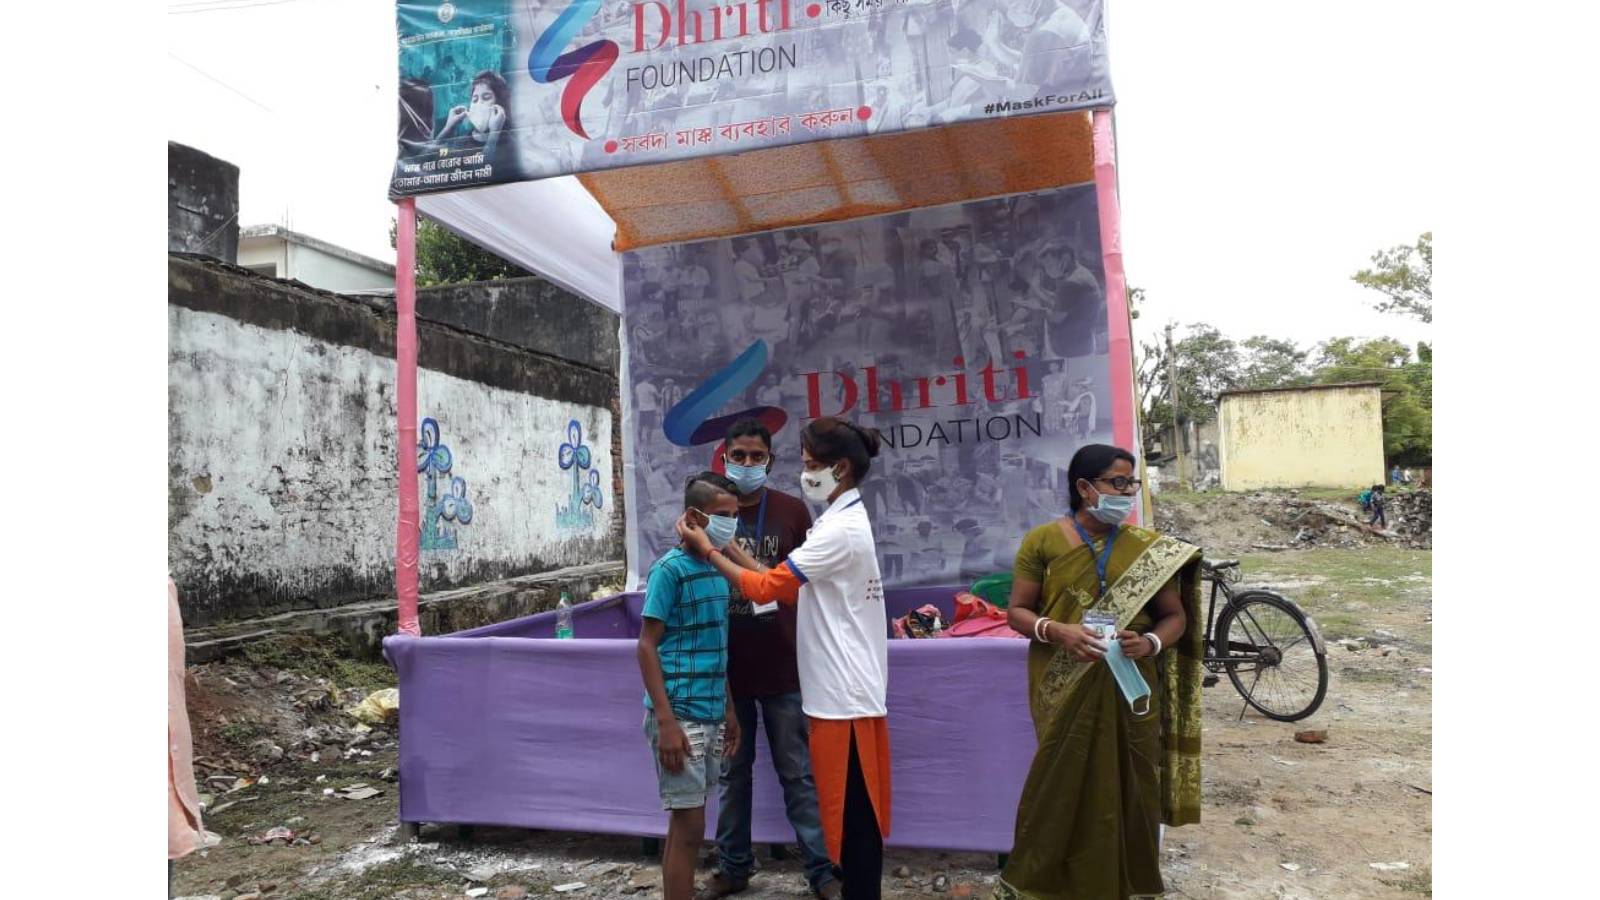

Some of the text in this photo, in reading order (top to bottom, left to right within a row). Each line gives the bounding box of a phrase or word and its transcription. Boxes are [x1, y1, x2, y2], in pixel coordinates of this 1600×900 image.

[628, 0, 793, 53] Dhriti
[626, 43, 796, 92] FOUNDATION
[984, 88, 1104, 114] #MaskForAll
[718, 114, 790, 142] ব্যবহার
[800, 107, 853, 130] করুন
[796, 350, 1039, 420] Dhriti
[880, 412, 1042, 450] NDATION
